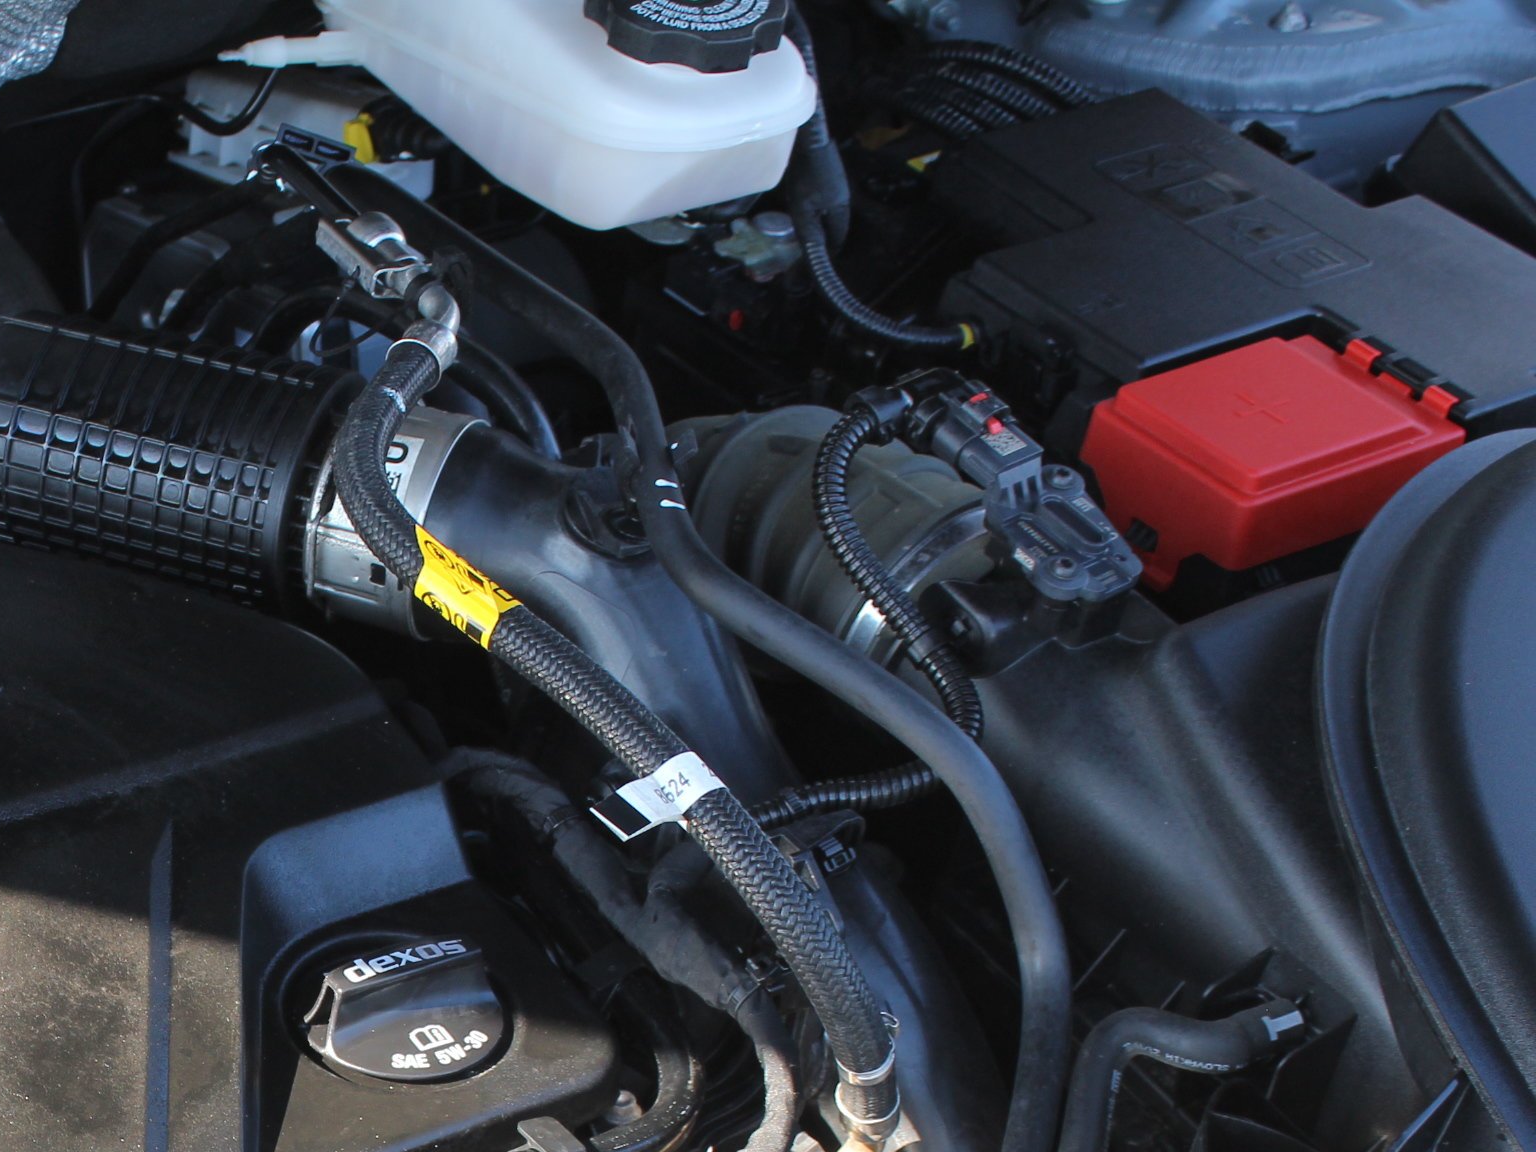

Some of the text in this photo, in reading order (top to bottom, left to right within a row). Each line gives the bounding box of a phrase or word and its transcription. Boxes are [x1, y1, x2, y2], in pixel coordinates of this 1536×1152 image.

[630, 4, 654, 17] DOT
[649, 13, 660, 21] 4
[656, 15, 690, 29] FLUID
[343, 939, 467, 983] dexos
[391, 1030, 489, 1069] SAE 5W-30
